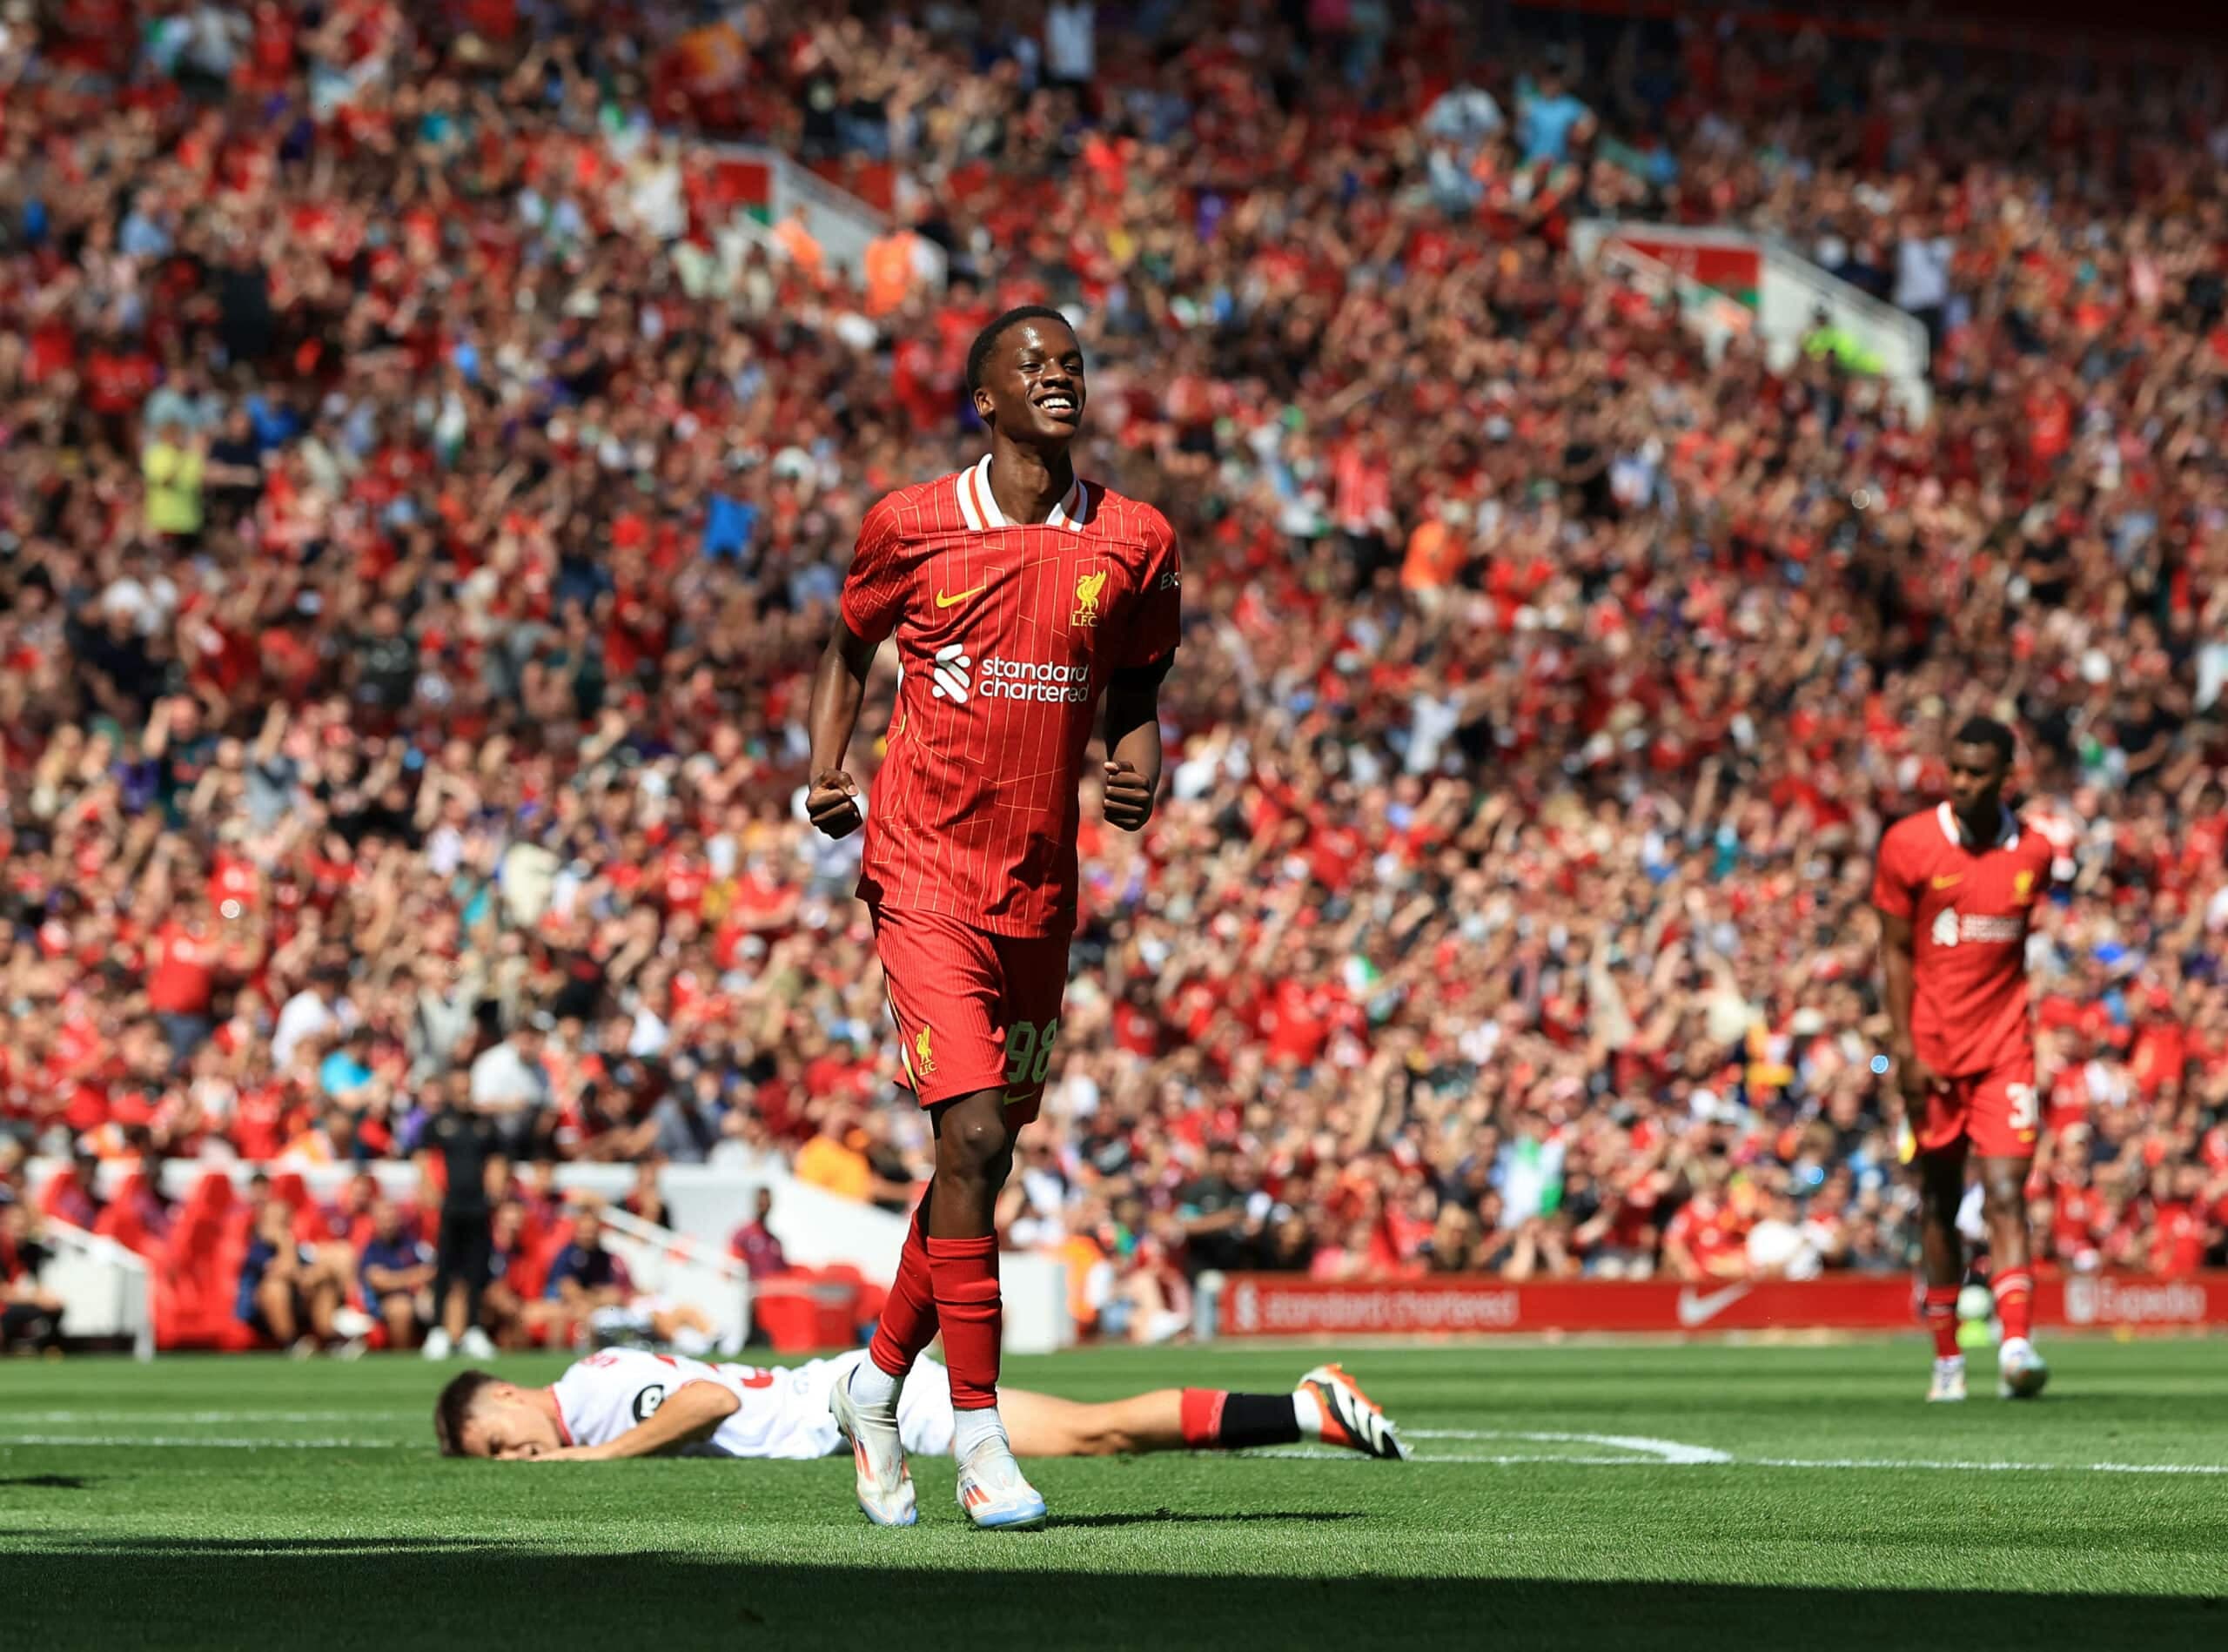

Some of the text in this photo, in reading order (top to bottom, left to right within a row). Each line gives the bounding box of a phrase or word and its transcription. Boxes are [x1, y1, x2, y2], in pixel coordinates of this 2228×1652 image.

[1071, 614, 1097, 627] LFC
[981, 656, 1089, 682] standard
[979, 677, 1090, 702] chartered
[1005, 1017, 1057, 1085] 98
[919, 1061, 937, 1076] LFC
[2005, 1083, 2039, 1129] 3
